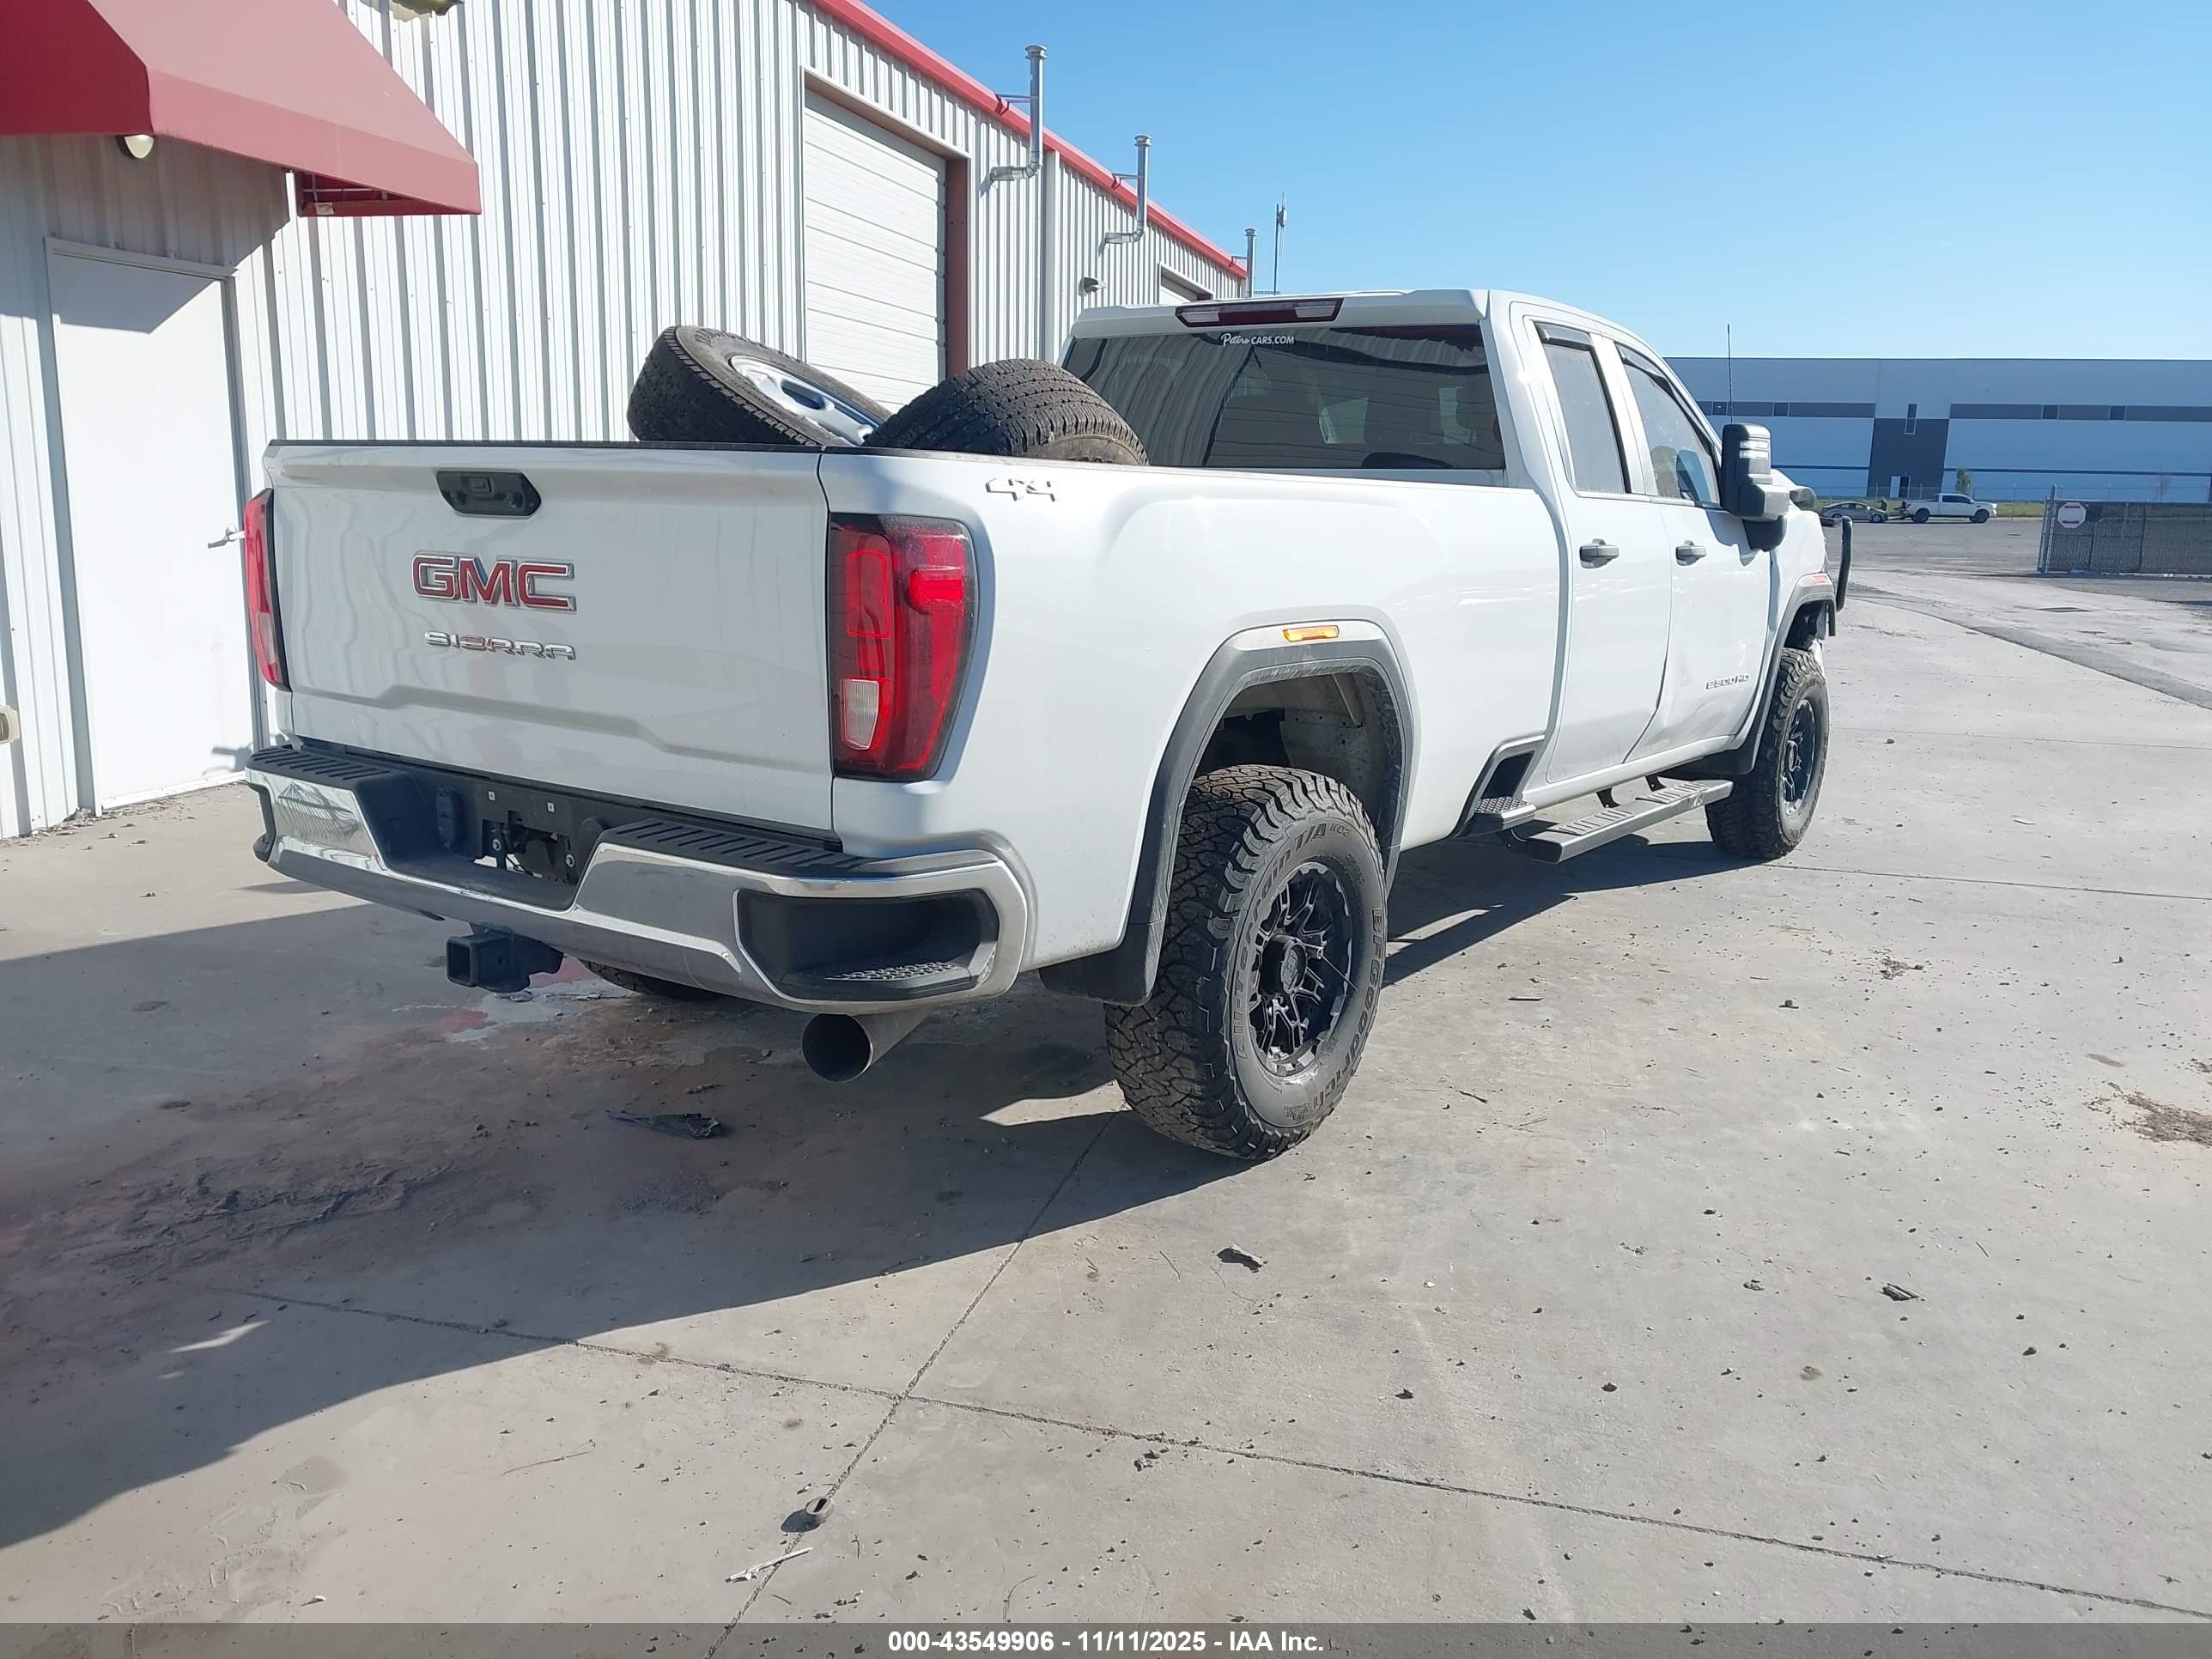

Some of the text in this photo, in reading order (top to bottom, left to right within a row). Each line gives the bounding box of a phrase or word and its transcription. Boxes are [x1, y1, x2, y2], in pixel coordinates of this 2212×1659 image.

[1251, 336, 1295, 345] CARS.COM
[411, 550, 576, 612] GMC
[424, 631, 576, 660] SIERRA
